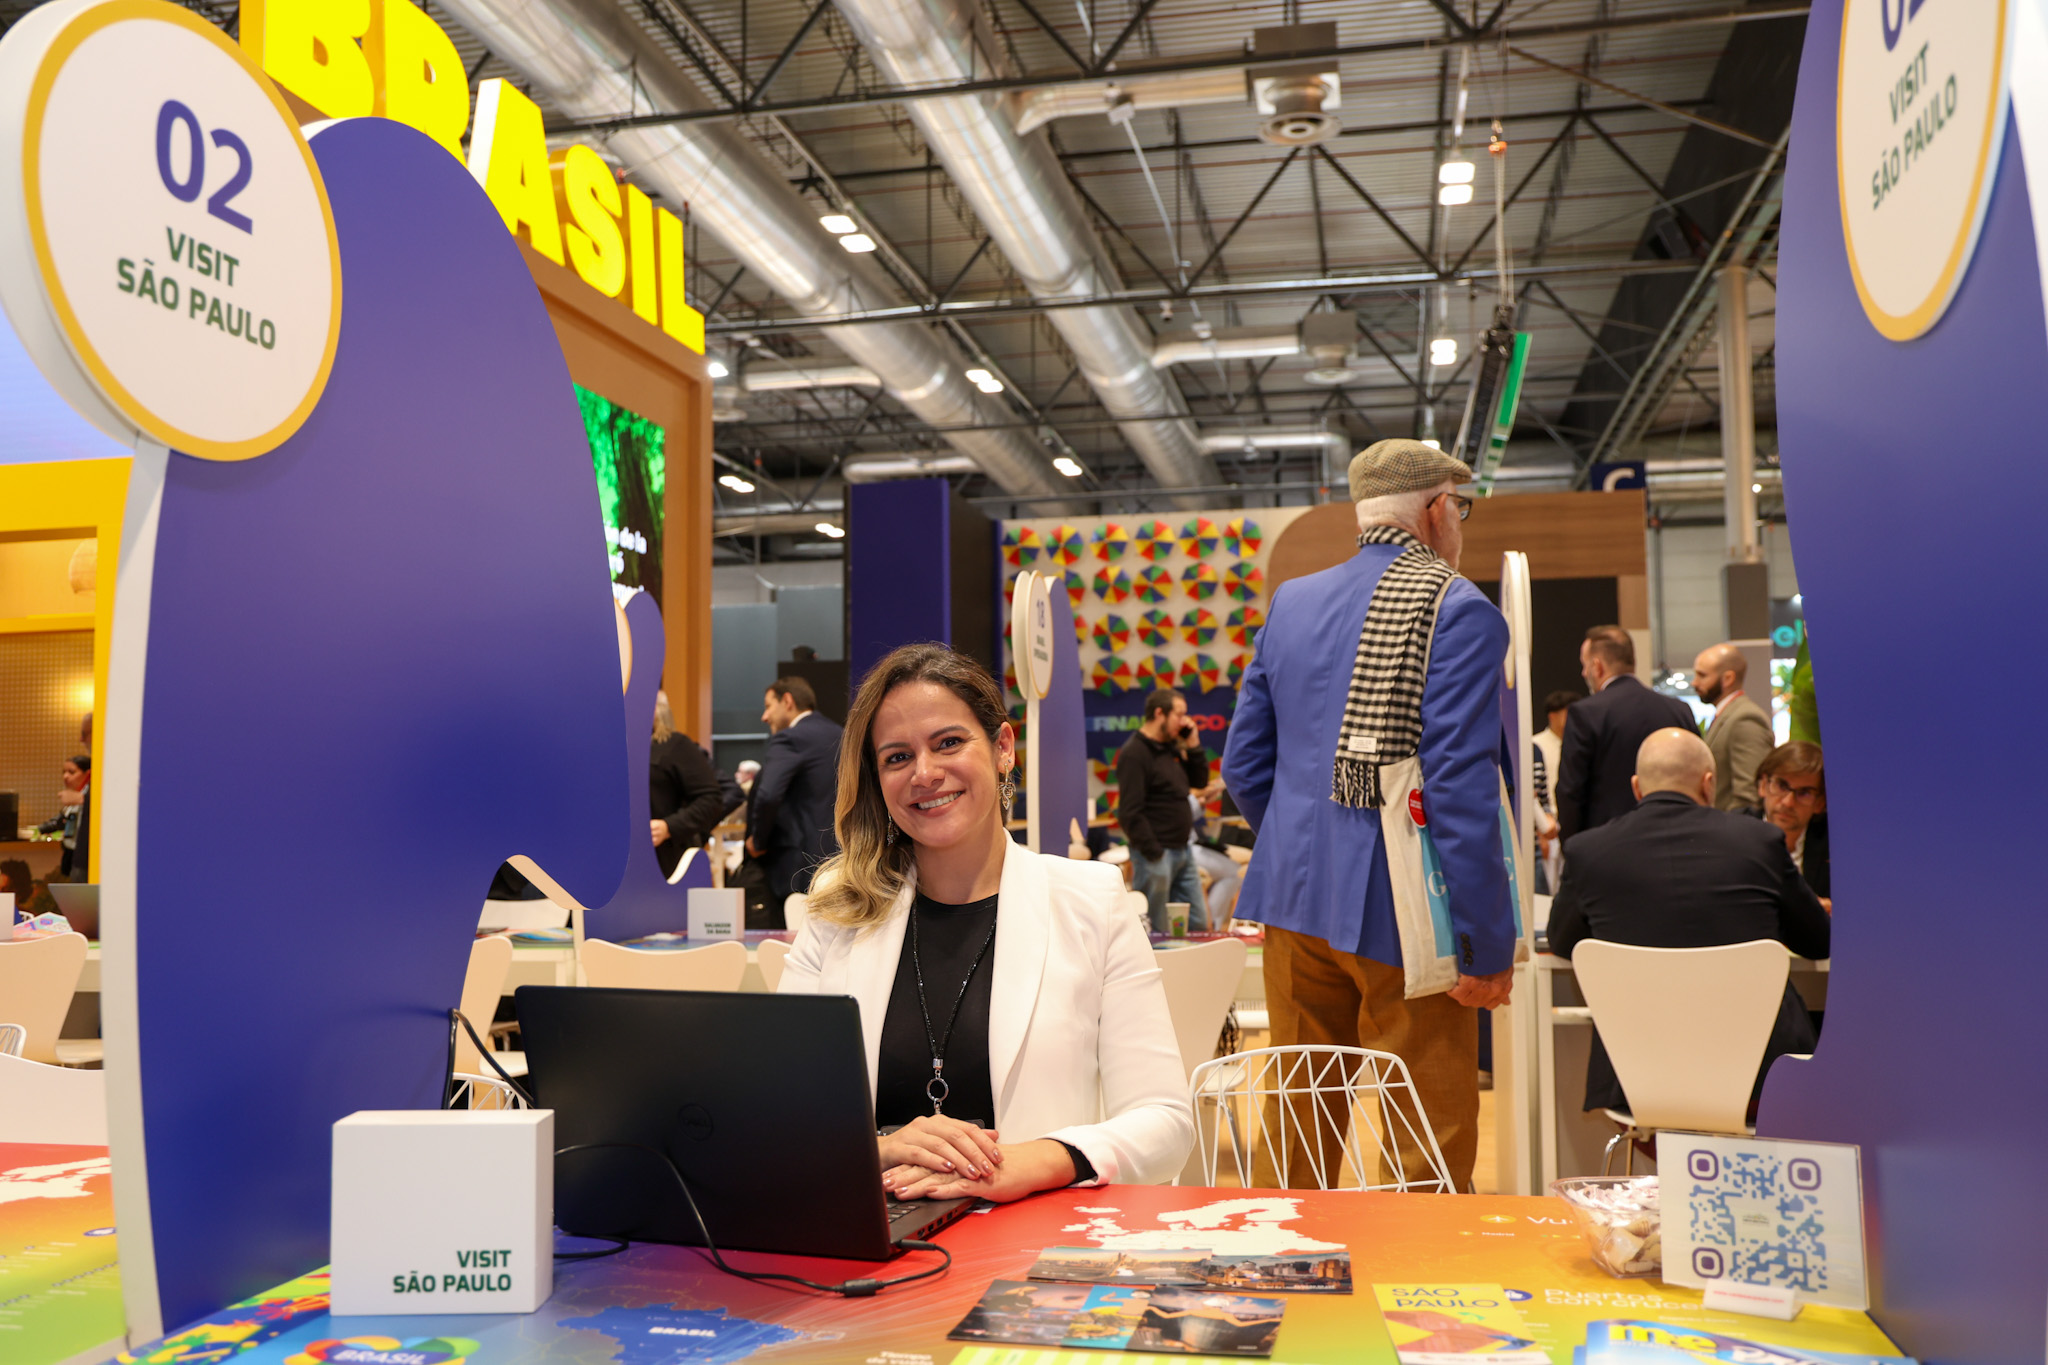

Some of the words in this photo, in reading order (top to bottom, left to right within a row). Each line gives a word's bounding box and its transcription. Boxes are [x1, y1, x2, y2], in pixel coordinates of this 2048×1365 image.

[1889, 40, 1930, 125] VISIT
[1871, 147, 1901, 211] SÃO
[1904, 72, 1958, 172] PAULO
[156, 98, 254, 235] 02
[165, 226, 240, 287] VISIT
[116, 257, 180, 312] SÃO
[188, 286, 277, 352] PAULO
[456, 1249, 512, 1269] VISIT
[392, 1270, 437, 1294] SÃO
[443, 1273, 512, 1293] PAULO
[1391, 1285, 1460, 1297] SÃO
[1395, 1298, 1500, 1309] PAULO
[1544, 1288, 1663, 1302] Puertos
[1545, 1297, 1603, 1307] con
[1612, 1299, 1704, 1310] cruce
[333, 1349, 427, 1365] BRASIL
